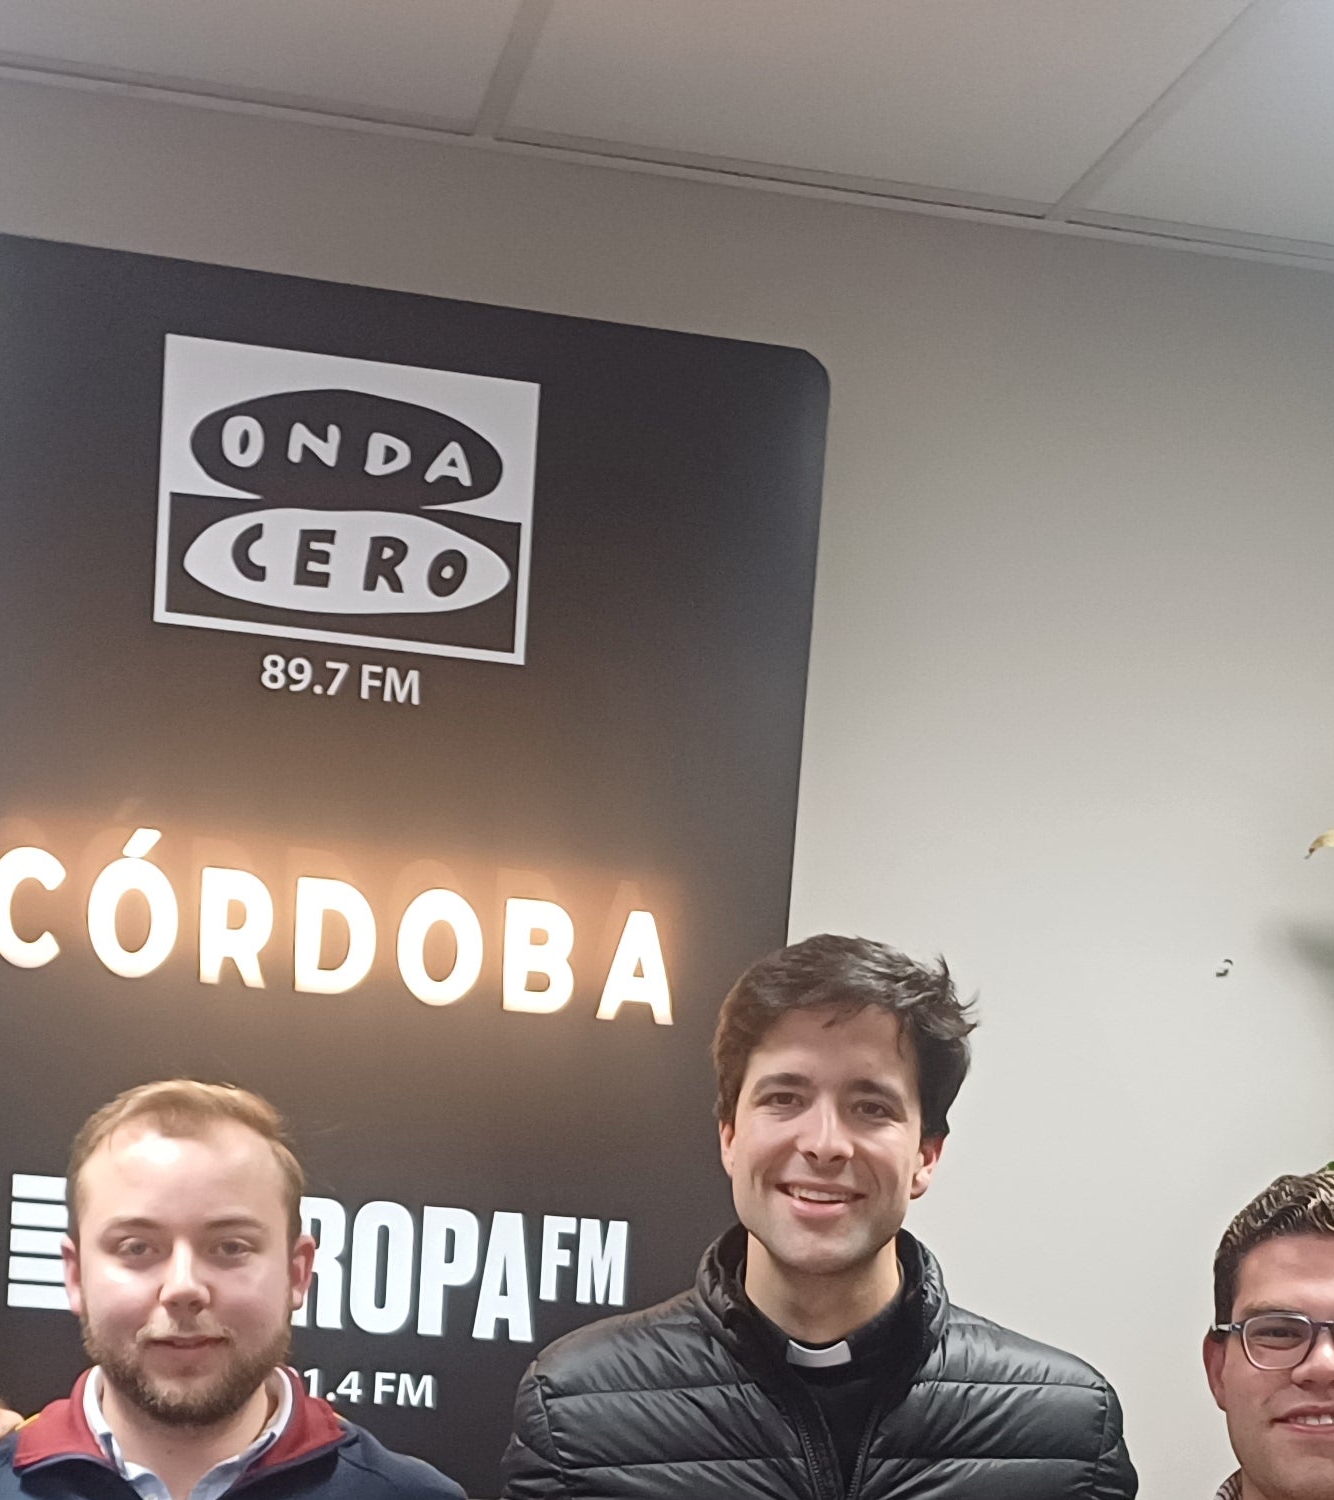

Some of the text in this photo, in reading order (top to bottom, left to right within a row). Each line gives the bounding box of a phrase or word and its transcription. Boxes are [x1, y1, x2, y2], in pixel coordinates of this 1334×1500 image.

[221, 415, 472, 486] ONDA
[231, 522, 468, 597] CERO
[260, 653, 420, 705] 89.7 FM
[290, 1196, 628, 1342] ROPA FM
[302, 1368, 435, 1408] 1.4 FM
